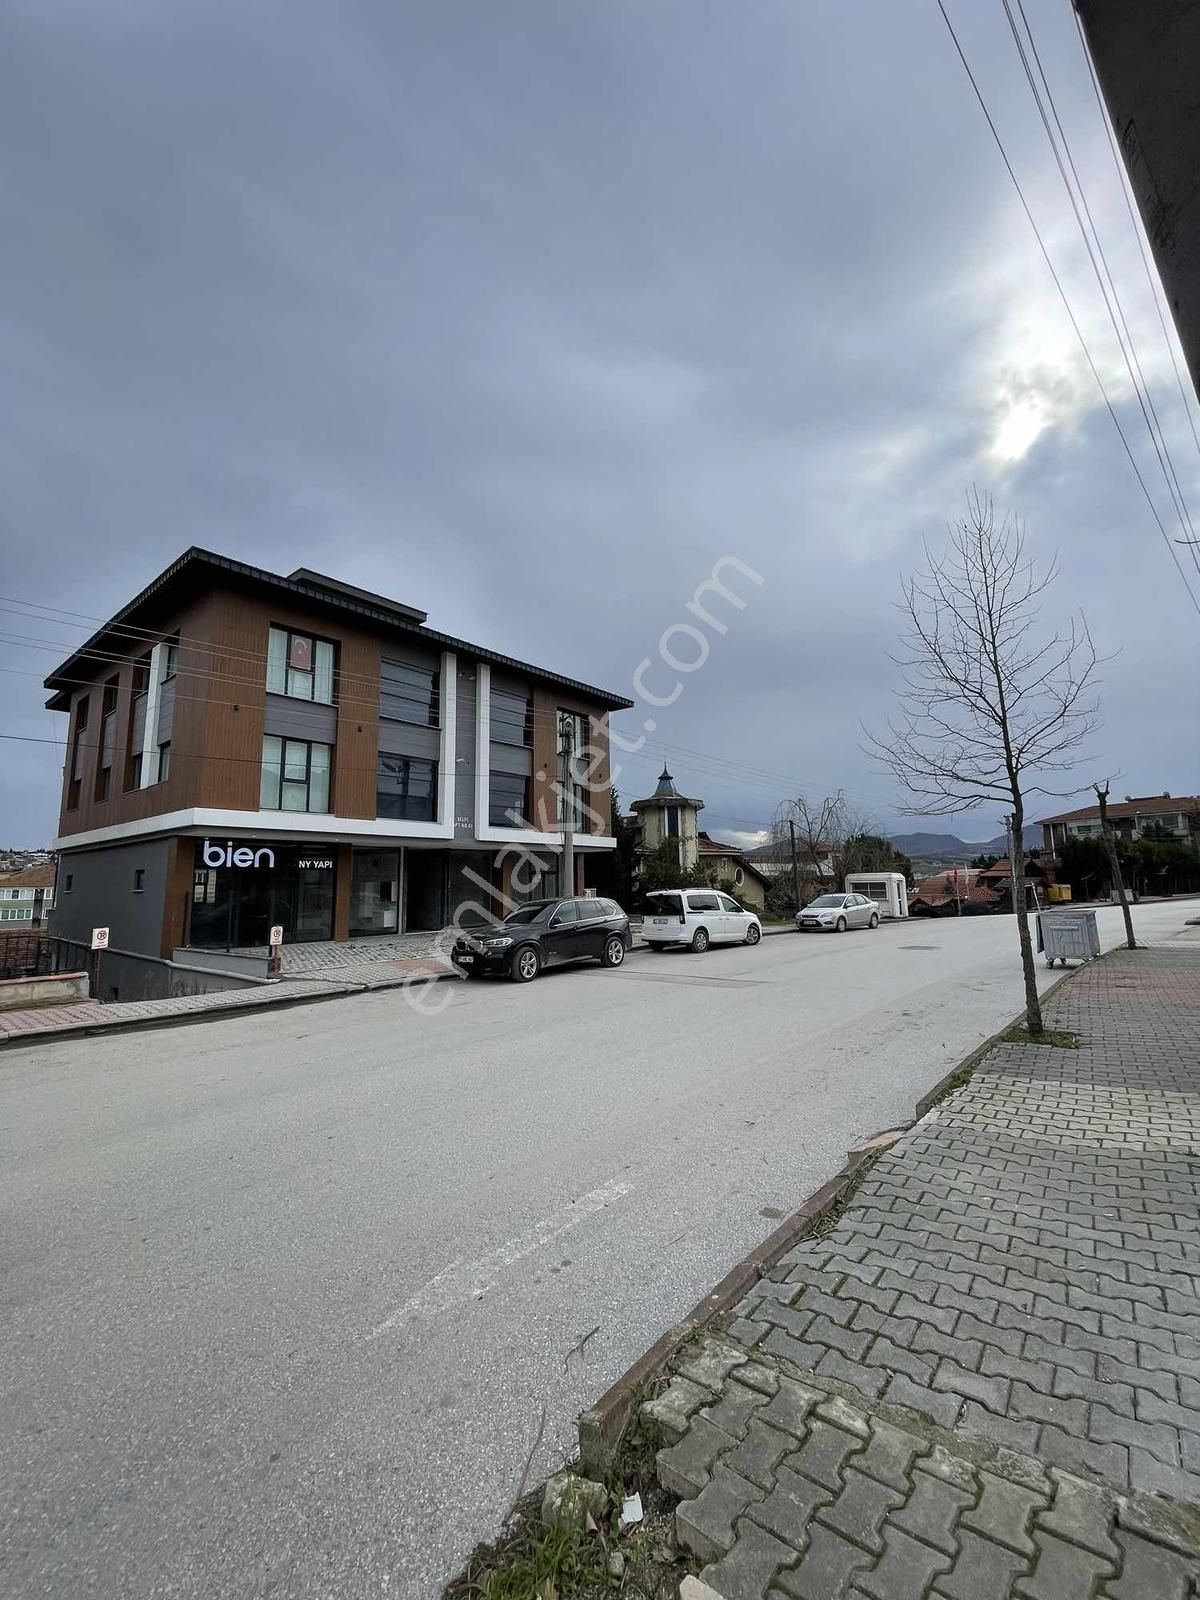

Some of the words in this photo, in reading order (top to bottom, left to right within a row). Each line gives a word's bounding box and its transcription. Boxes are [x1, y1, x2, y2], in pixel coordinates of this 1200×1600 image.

[203, 840, 275, 868] bien
[298, 860, 311, 869] NY
[313, 860, 334, 869] YAPI
